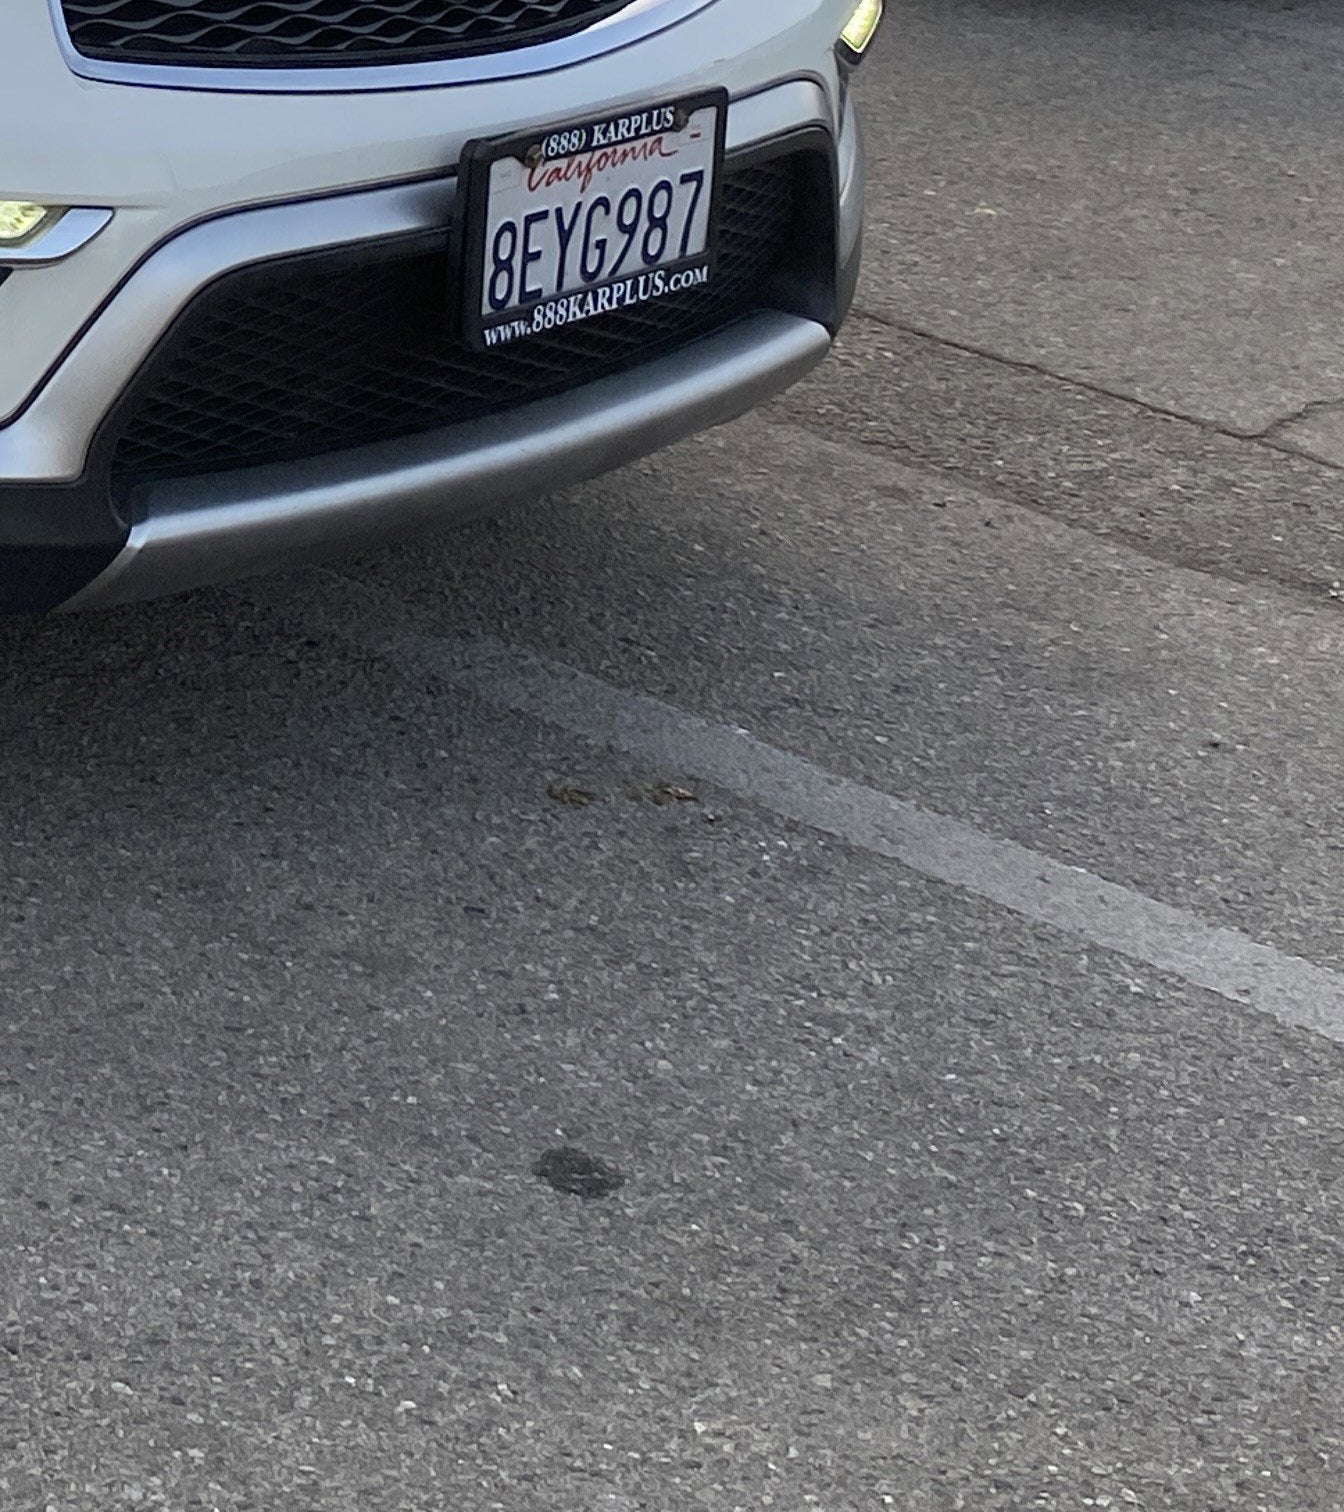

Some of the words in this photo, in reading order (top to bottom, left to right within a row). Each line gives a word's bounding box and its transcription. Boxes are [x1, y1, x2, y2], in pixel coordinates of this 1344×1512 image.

[541, 128, 587, 157] (888)
[590, 106, 676, 148] KARPLUS
[526, 134, 680, 194] California
[487, 168, 706, 312] 8EYG987
